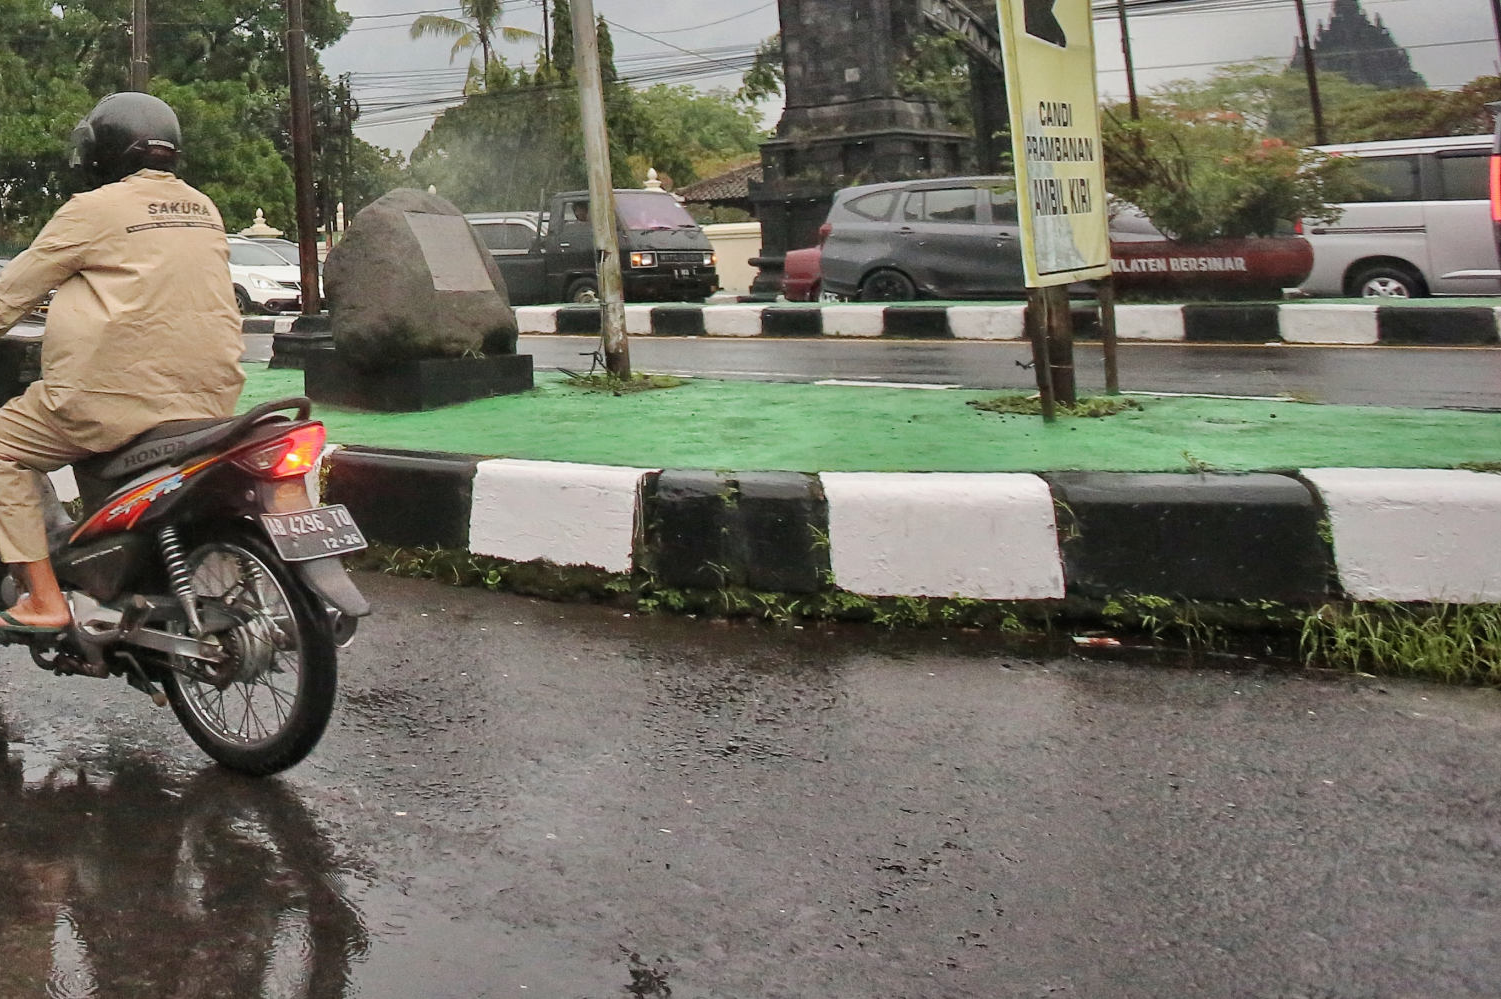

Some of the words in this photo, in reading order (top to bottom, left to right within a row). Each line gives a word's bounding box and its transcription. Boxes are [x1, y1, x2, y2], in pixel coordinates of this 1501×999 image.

[1039, 100, 1073, 128] CANDI
[1026, 135, 1094, 162] PRAMBANAN
[147, 202, 211, 217] SAKURA
[1034, 178, 1069, 217] AMBIL
[1067, 178, 1093, 215] KIRI
[1168, 256, 1248, 273] BERSINAR
[268, 518, 288, 536] AB
[289, 513, 325, 535] 4296
